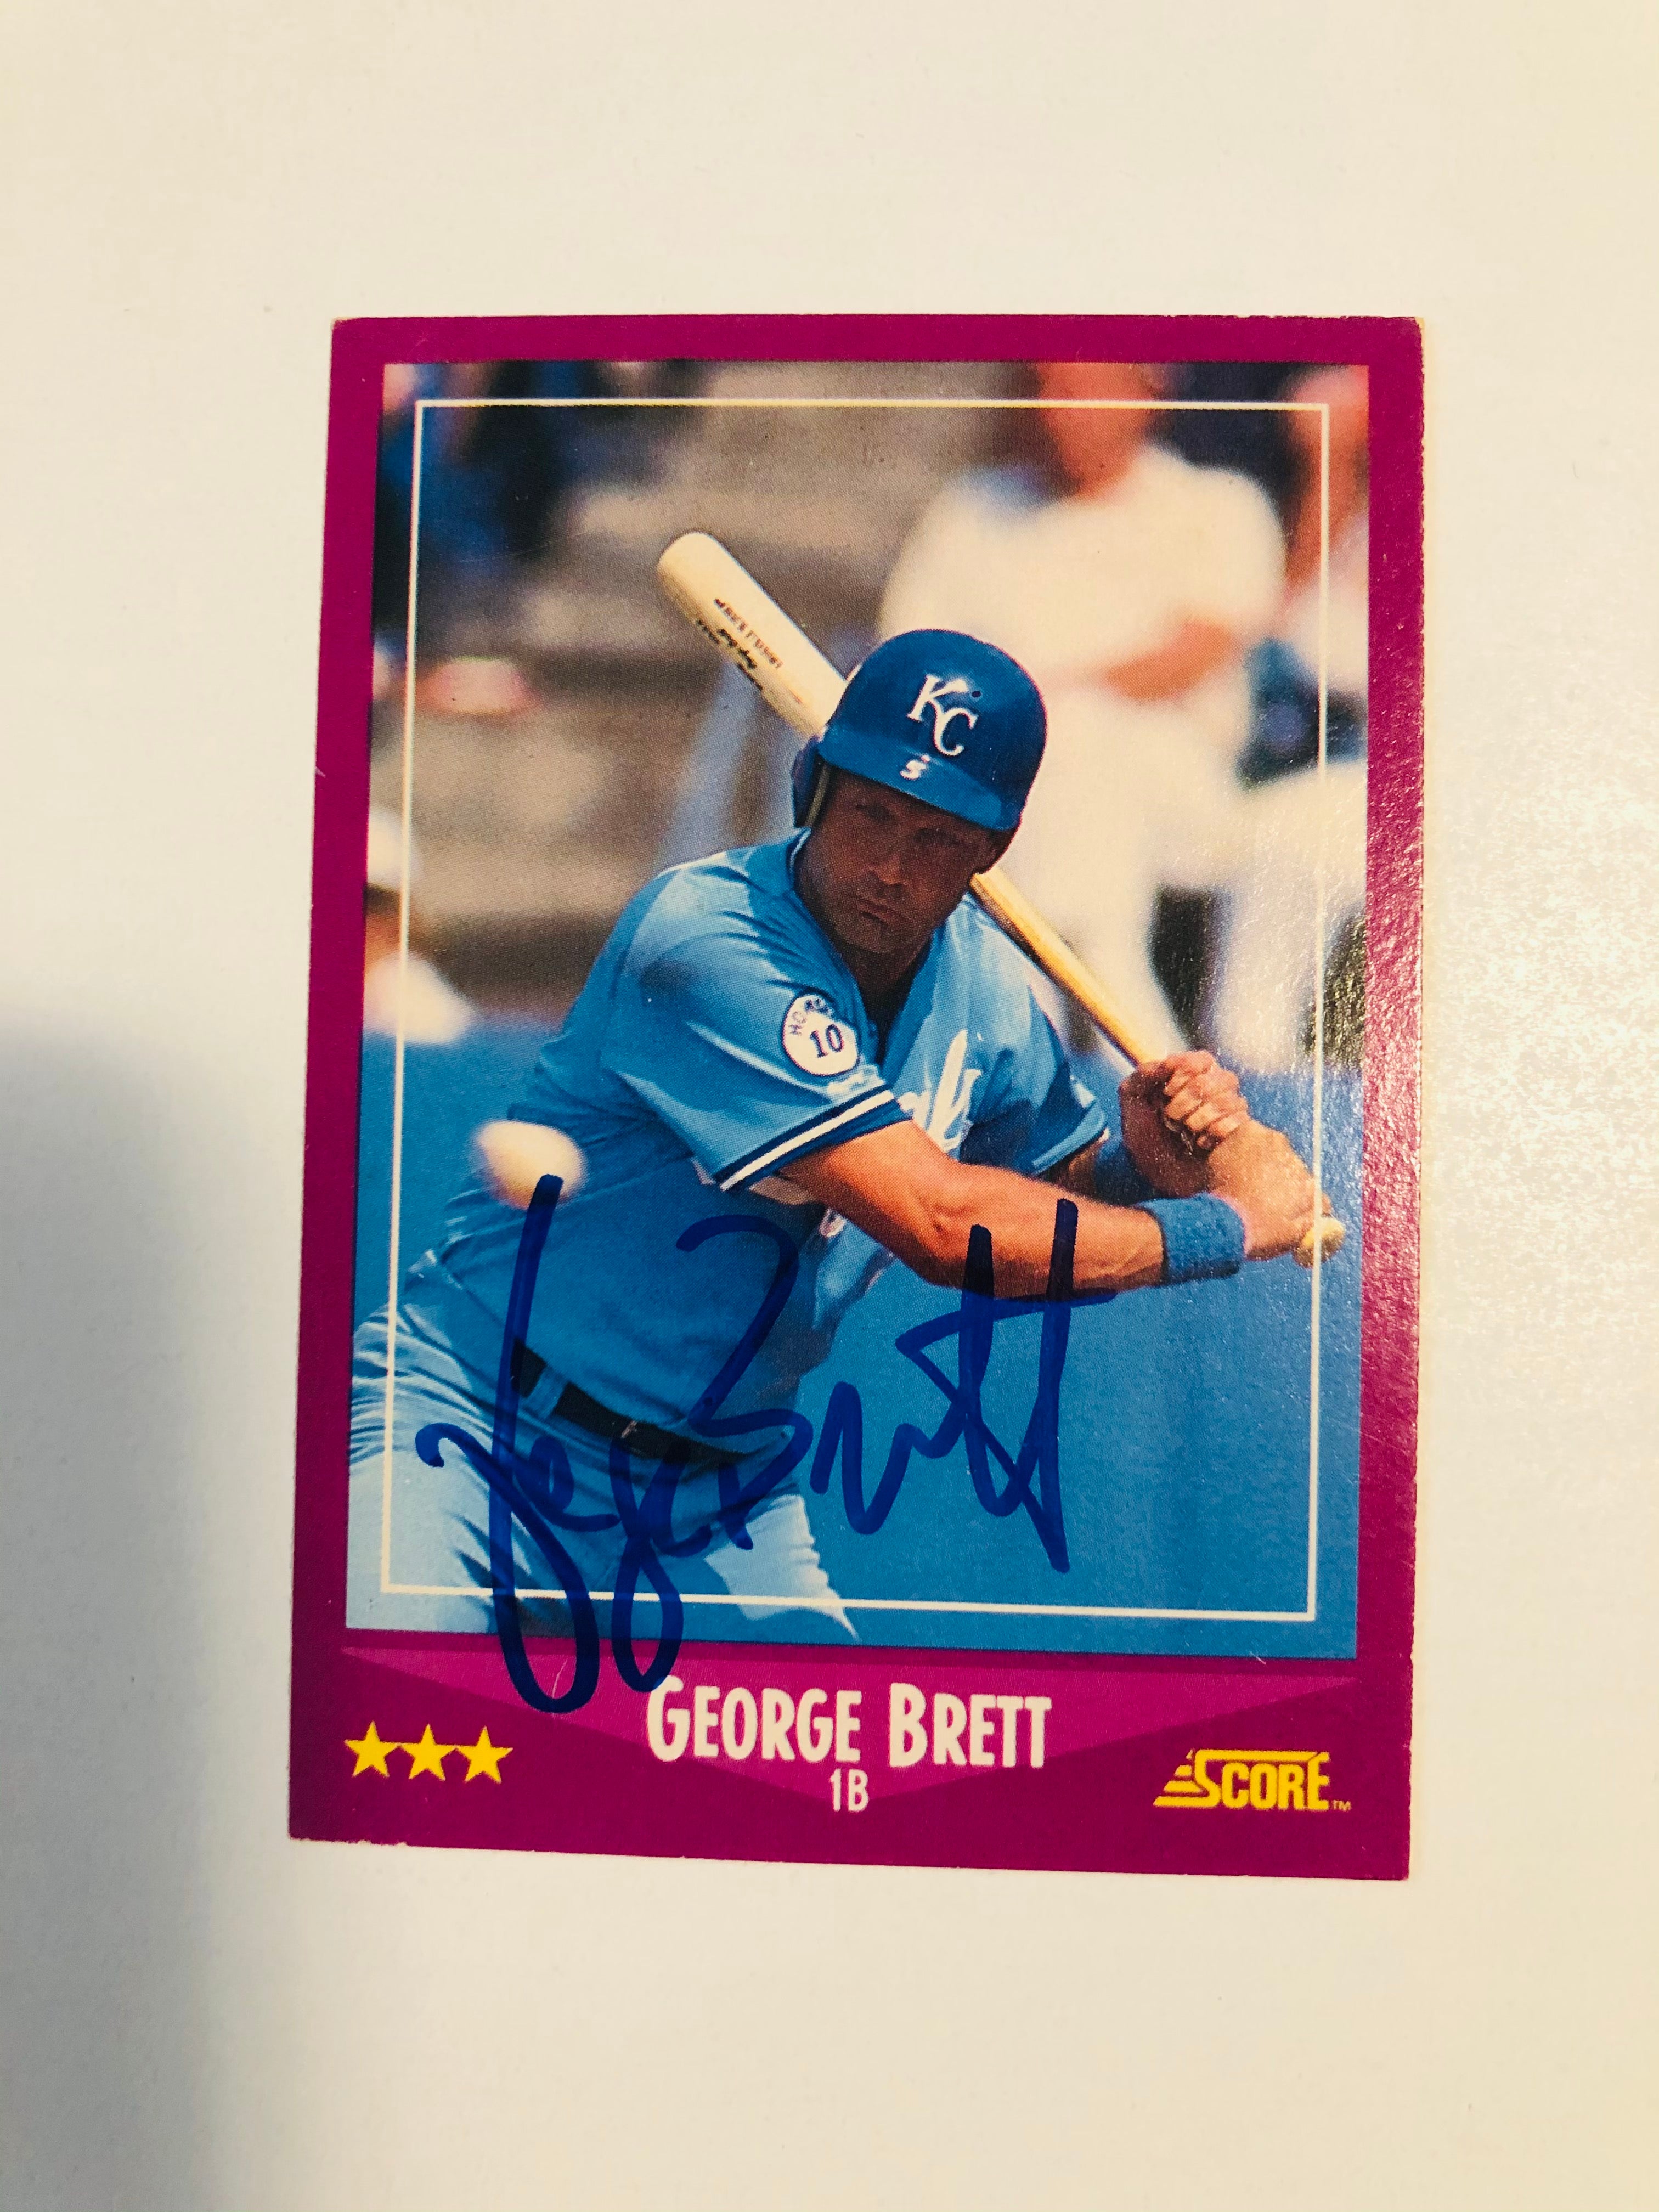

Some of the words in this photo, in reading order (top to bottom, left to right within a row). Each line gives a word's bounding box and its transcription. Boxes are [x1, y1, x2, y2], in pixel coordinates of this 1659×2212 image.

[907, 674, 979, 757] KC
[809, 1024, 845, 1058] 10
[830, 1768, 869, 1813] 1B
